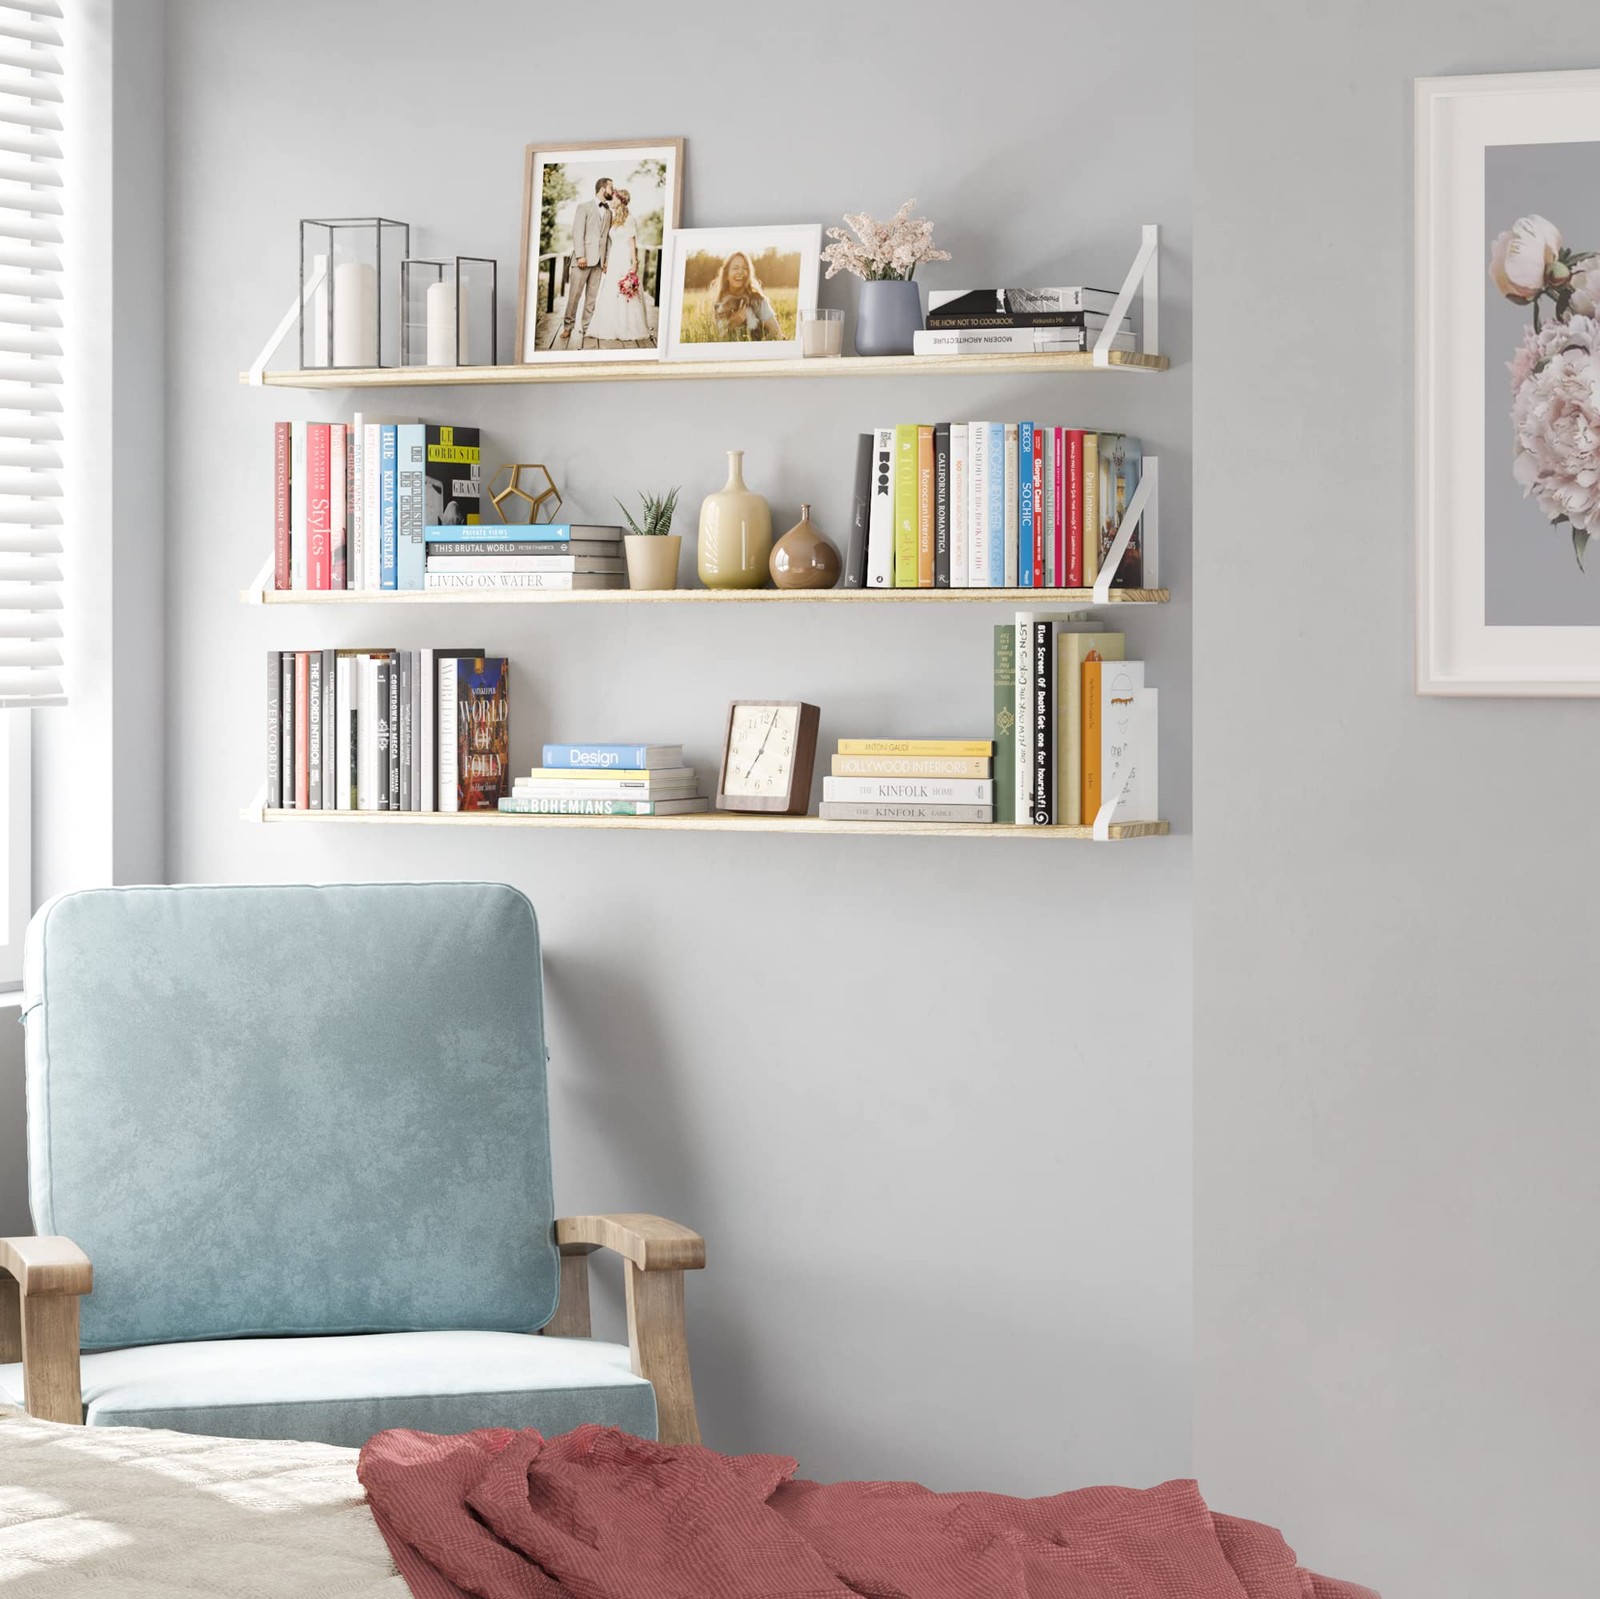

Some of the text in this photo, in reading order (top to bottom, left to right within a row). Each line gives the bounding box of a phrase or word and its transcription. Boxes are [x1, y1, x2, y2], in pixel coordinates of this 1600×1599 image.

[930, 319, 940, 327] THE
[941, 318, 955, 327] HOW
[957, 318, 969, 326] NOT
[970, 318, 978, 326] TO
[979, 317, 1014, 326] COOKBOOK
[314, 430, 320, 440] OF
[441, 429, 452, 443] LE
[974, 427, 983, 452] MILES
[1022, 428, 1031, 453] DECOR
[278, 462, 285, 473] TO
[877, 451, 891, 496] BOOK
[1033, 458, 1042, 487] Giorgio
[347, 444, 355, 515] CHINA STYLE
[974, 479, 983, 495] THE
[383, 432, 395, 569] HUE KELLY WEARSTLER
[401, 471, 411, 536] LE GRAND
[412, 447, 422, 543] LE CORBUSIER
[938, 453, 946, 554] CALIFORNIA ROMANTICA
[974, 496, 983, 511] BIG
[991, 440, 1002, 572] OSCAR NIEMEYER HOUSES
[1022, 482, 1032, 527] SO CHIC
[1034, 489, 1042, 513] Casali
[1085, 472, 1094, 531] Paris Interiors
[308, 498, 331, 556] Styles
[488, 528, 509, 536] VIEWS
[974, 512, 983, 536] BOOK
[434, 544, 453, 552] THIS
[455, 544, 484, 552] BRUTAL
[486, 543, 515, 552] WORLD
[974, 538, 983, 548] OF
[974, 550, 983, 570] CHIC
[429, 575, 543, 587] LIVING ON WATER
[1020, 622, 1028, 648] NEST
[1037, 624, 1046, 644] Blue
[311, 662, 319, 680] THE
[1037, 647, 1046, 674] Screen
[311, 681, 319, 722] TAILORED
[459, 700, 508, 722] WORLD
[1037, 691, 1046, 714] Death
[441, 663, 453, 785] WORLD OF FOLLY
[748, 719, 757, 729] 11
[760, 714, 770, 724] 12
[1018, 703, 1026, 724] OVER
[1037, 715, 1046, 729] Get
[391, 723, 397, 731] TO
[268, 699, 278, 780] VERVOORDT
[311, 724, 319, 765] INTERIOR
[475, 727, 493, 750] OF
[1037, 732, 1046, 747] one
[464, 754, 502, 777] FOLLY
[570, 749, 619, 766] Design
[841, 760, 968, 773] HOLLYWOOD INTERIORS
[1037, 751, 1046, 764] for
[859, 786, 872, 794] THE
[878, 785, 928, 797] KINFOLK
[1037, 768, 1046, 808] hourself!
[531, 800, 613, 814] BOHEMIANS
[876, 808, 926, 817] KINFOLK
